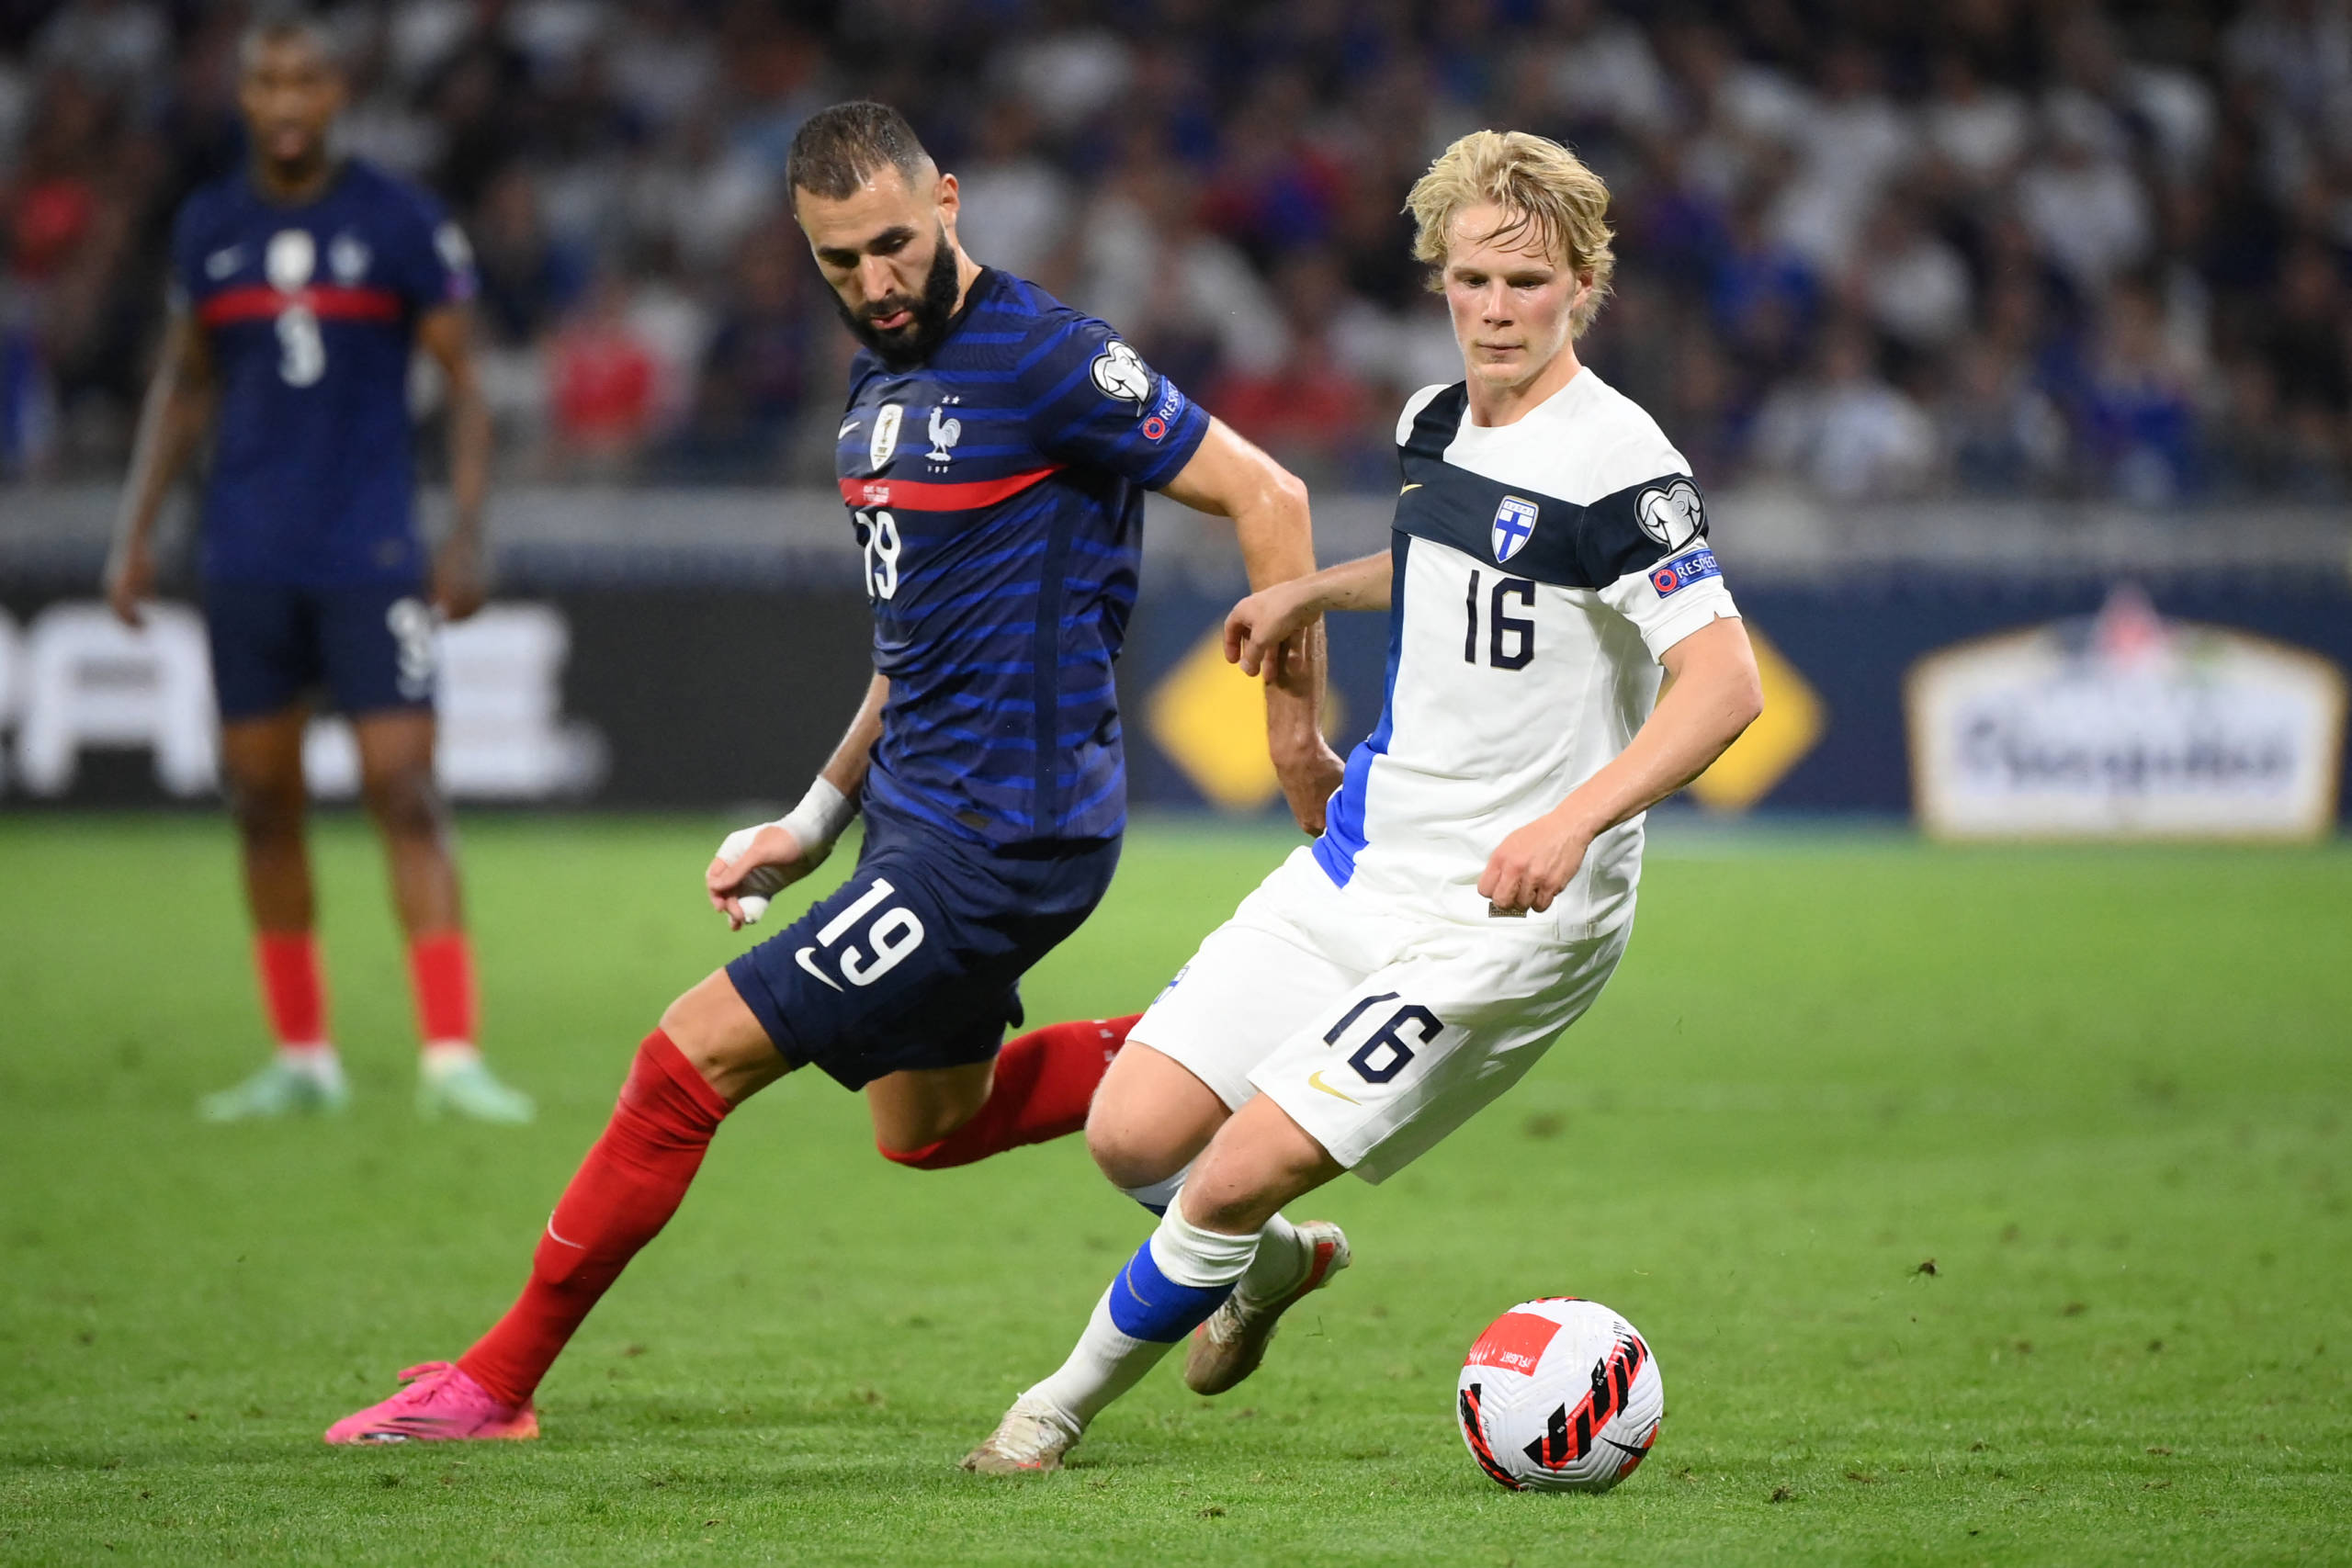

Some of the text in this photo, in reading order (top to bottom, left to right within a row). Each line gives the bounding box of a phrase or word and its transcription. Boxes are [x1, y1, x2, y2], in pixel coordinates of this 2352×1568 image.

[854, 511, 900, 600] 19
[1464, 570, 1536, 671] 16
[816, 877, 925, 986] 19
[1323, 991, 1444, 1084] 16
